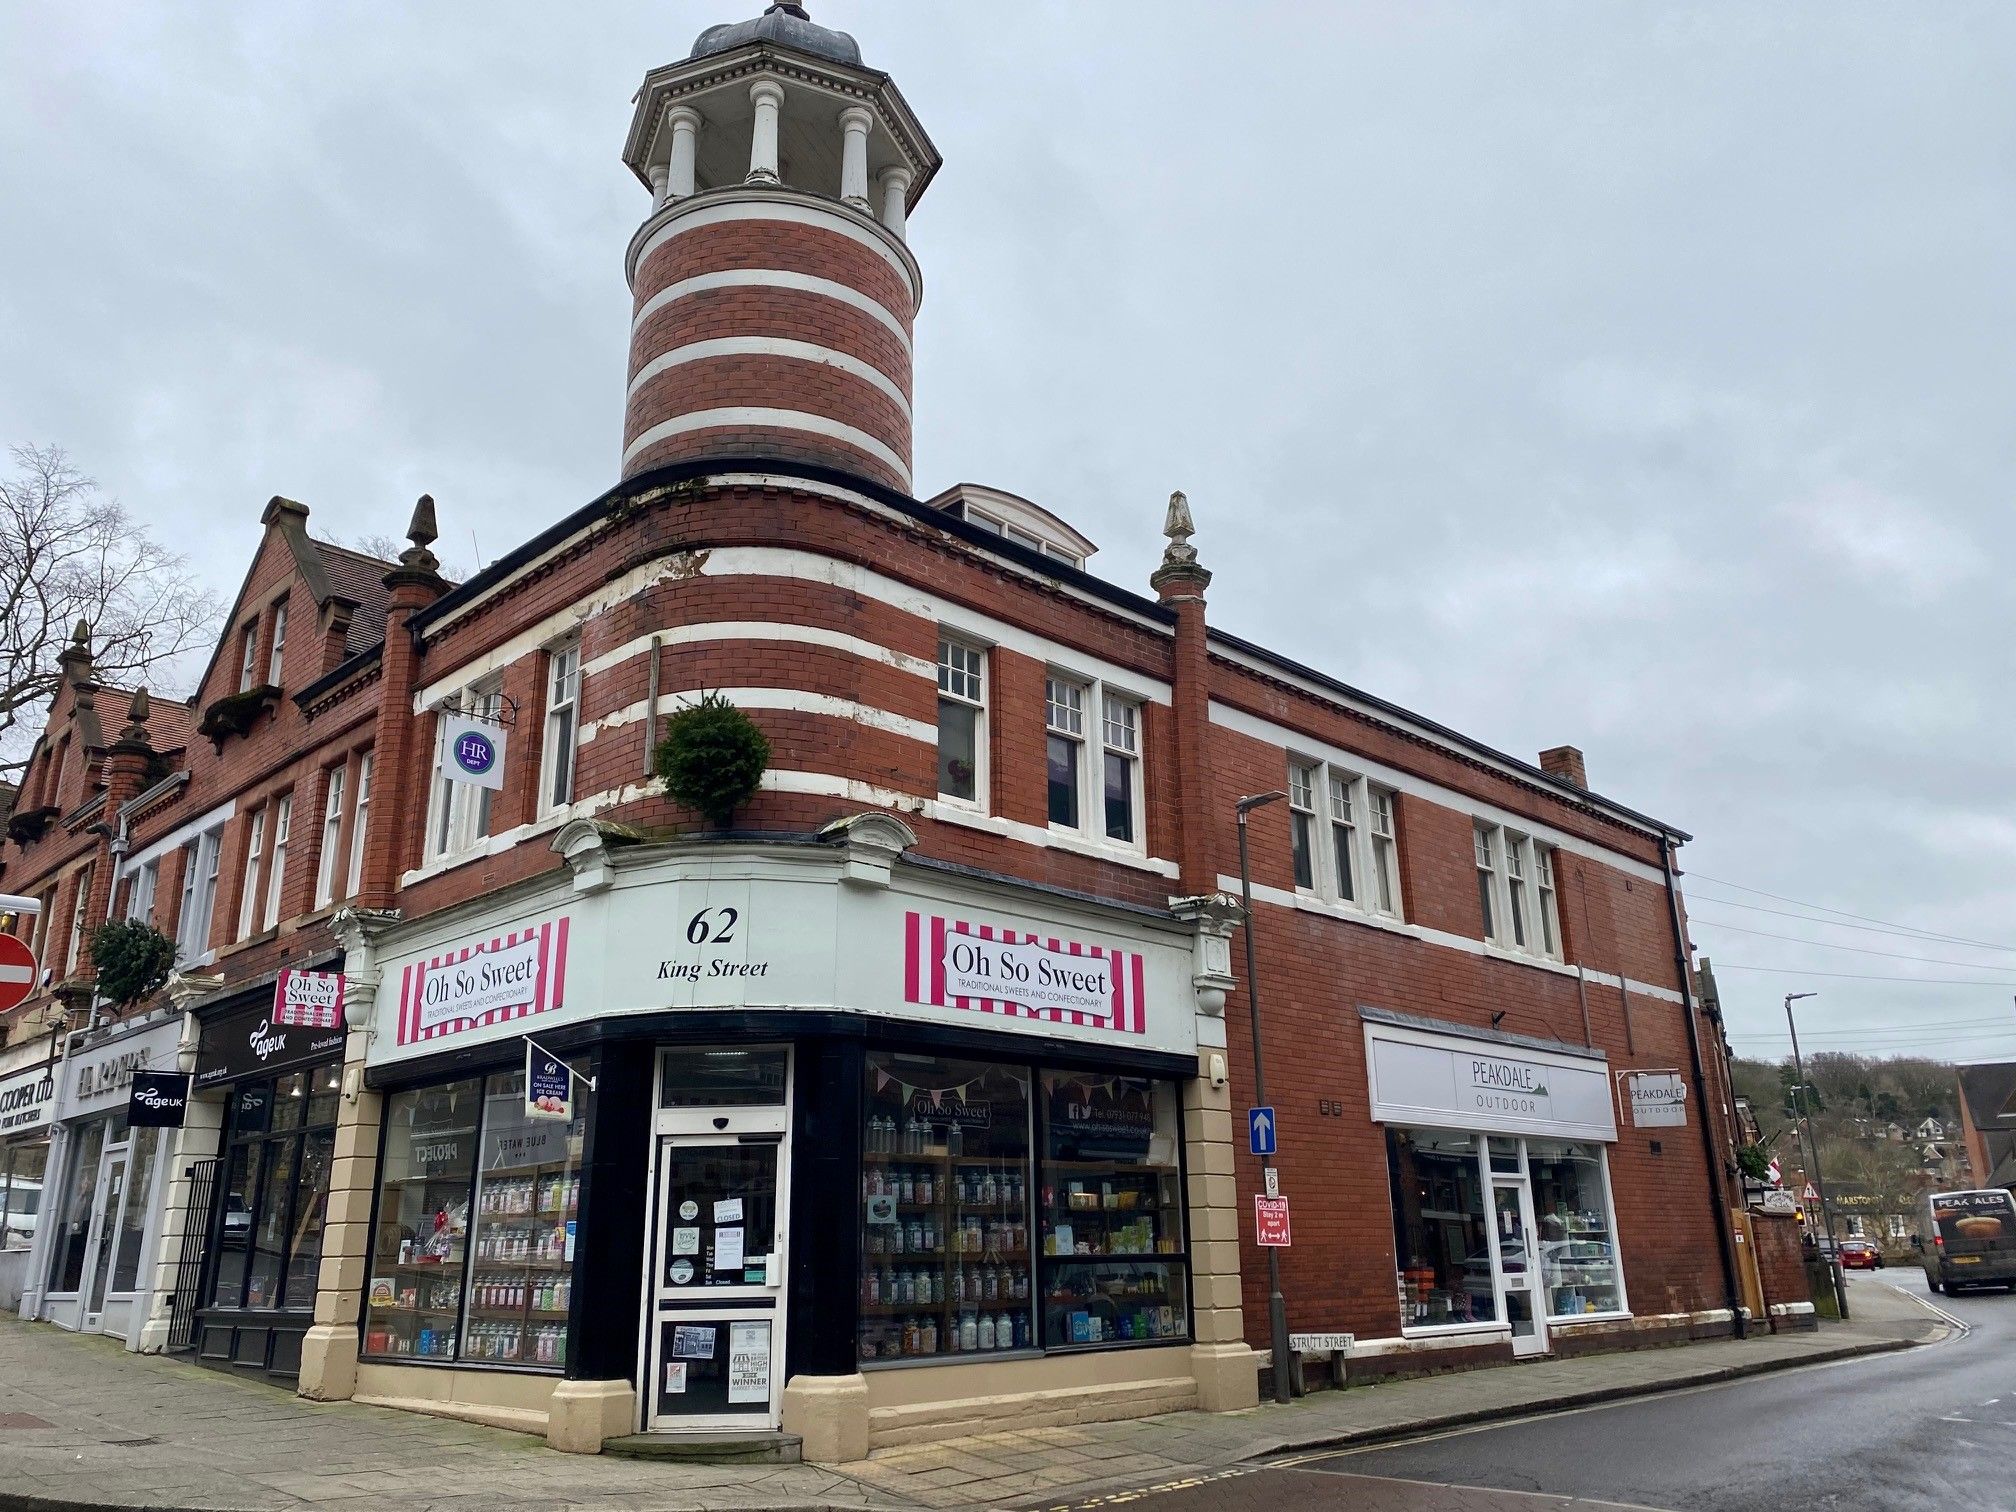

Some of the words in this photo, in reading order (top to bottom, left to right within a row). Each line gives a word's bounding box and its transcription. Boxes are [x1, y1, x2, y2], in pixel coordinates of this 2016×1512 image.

[461, 741, 487, 760] HR
[687, 907, 738, 944] 62
[657, 960, 702, 982] King
[707, 959, 768, 977] Street
[953, 944, 991, 976] Oh
[1000, 952, 1029, 982] So
[1038, 958, 1106, 994] Sweet
[290, 978, 311, 991] Oh
[317, 981, 334, 993] So
[426, 974, 449, 1005] Oh
[455, 970, 474, 998] So
[480, 955, 533, 991] Sweet
[289, 990, 332, 1004] Sweet
[958, 978, 1003, 994] TRADITIONAL
[1004, 986, 1029, 997] SWEETS
[1030, 990, 1046, 1000] AND
[1047, 993, 1102, 1007] CONFECTIONARY
[427, 1006, 454, 1018] TRADITIONAL
[455, 1002, 472, 1013] SWEETS
[473, 999, 485, 1009] AND
[1473, 1061, 1533, 1089] PEAKDALE
[1, 1083, 35, 1113] COOPER
[35, 1079, 54, 1103] LTD
[1477, 1095, 1535, 1112] OUTDOOR
[1631, 1089, 1682, 1100] PEAKDALE
[917, 1100, 934, 1115] Oh
[938, 1101, 951, 1116] So
[955, 1103, 986, 1118] Sweet
[1258, 1200, 1286, 1209] COVID-19
[1938, 1198, 1969, 1207] PEAK
[1974, 1196, 2004, 1204] ALES
[716, 1213, 741, 1222] CLOSED
[1263, 1211, 1273, 1219] Stay
[1292, 1336, 1322, 1348] STRUTT
[1325, 1336, 1351, 1347] STREET
